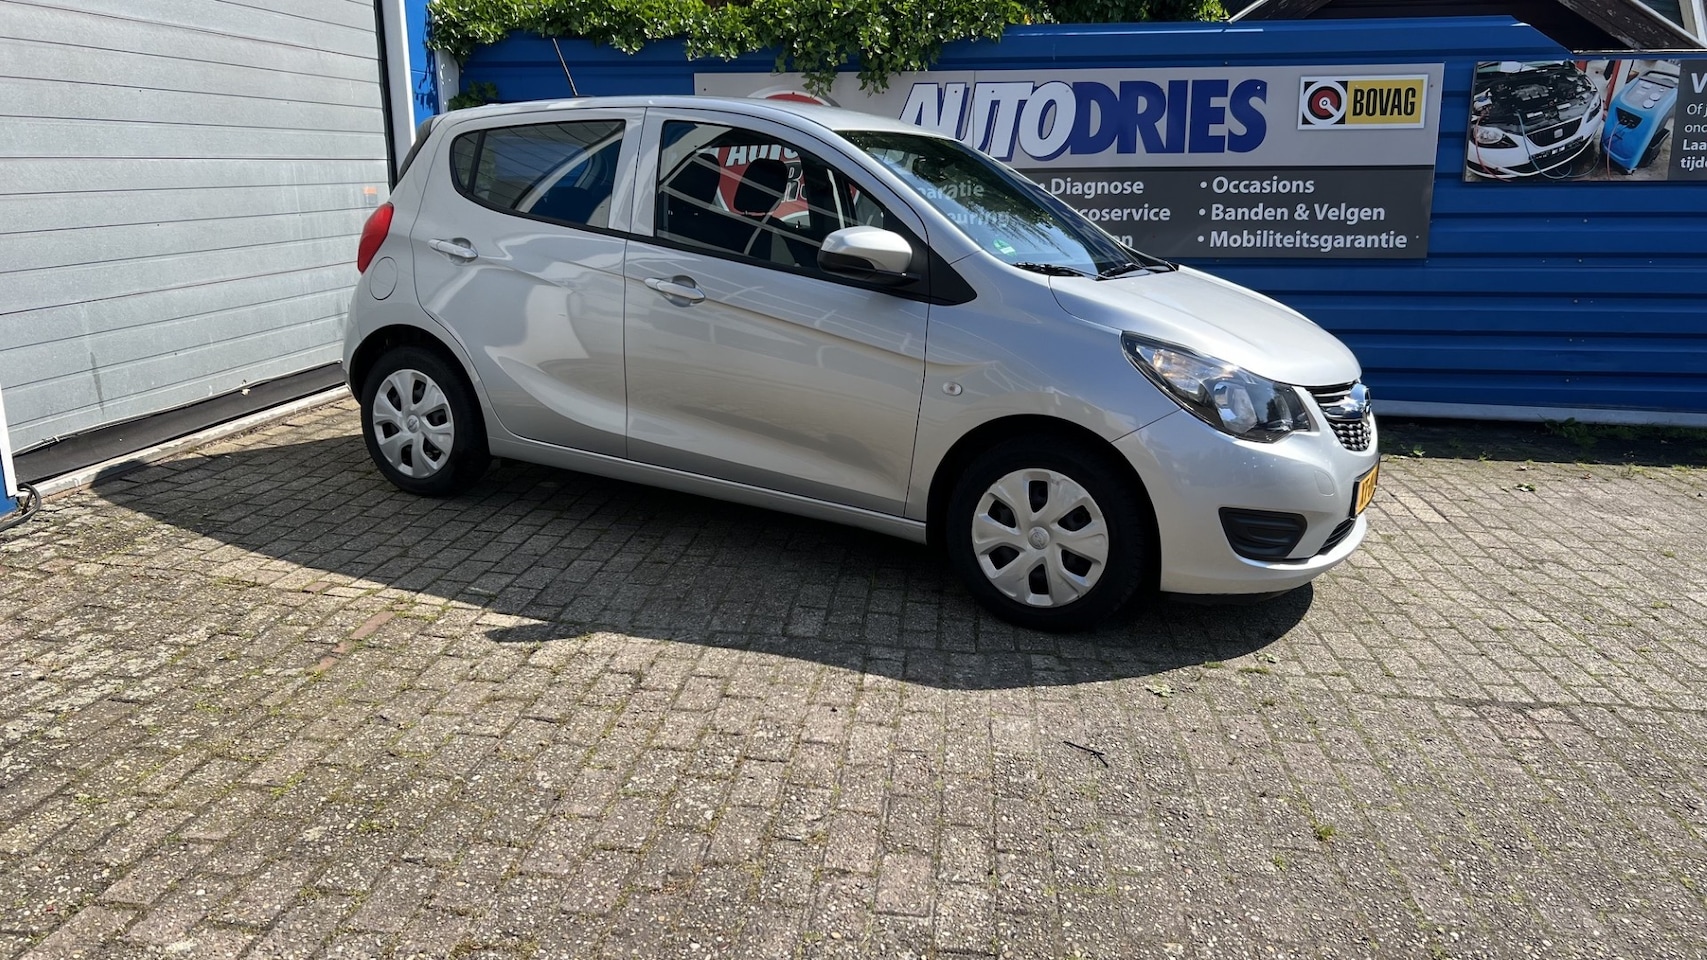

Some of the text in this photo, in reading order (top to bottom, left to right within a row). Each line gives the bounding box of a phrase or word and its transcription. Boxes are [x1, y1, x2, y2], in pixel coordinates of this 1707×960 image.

[1352, 87, 1416, 117] BOVAG
[1686, 103, 1703, 115] Of
[1680, 156, 1707, 172] tijd
[1050, 177, 1145, 199] Diagnose
[1212, 175, 1315, 194] Occasions
[1076, 203, 1171, 221] coservice
[1211, 203, 1386, 225] Banden & Velgen
[1209, 230, 1408, 252] Mobiliteitsgarantie
